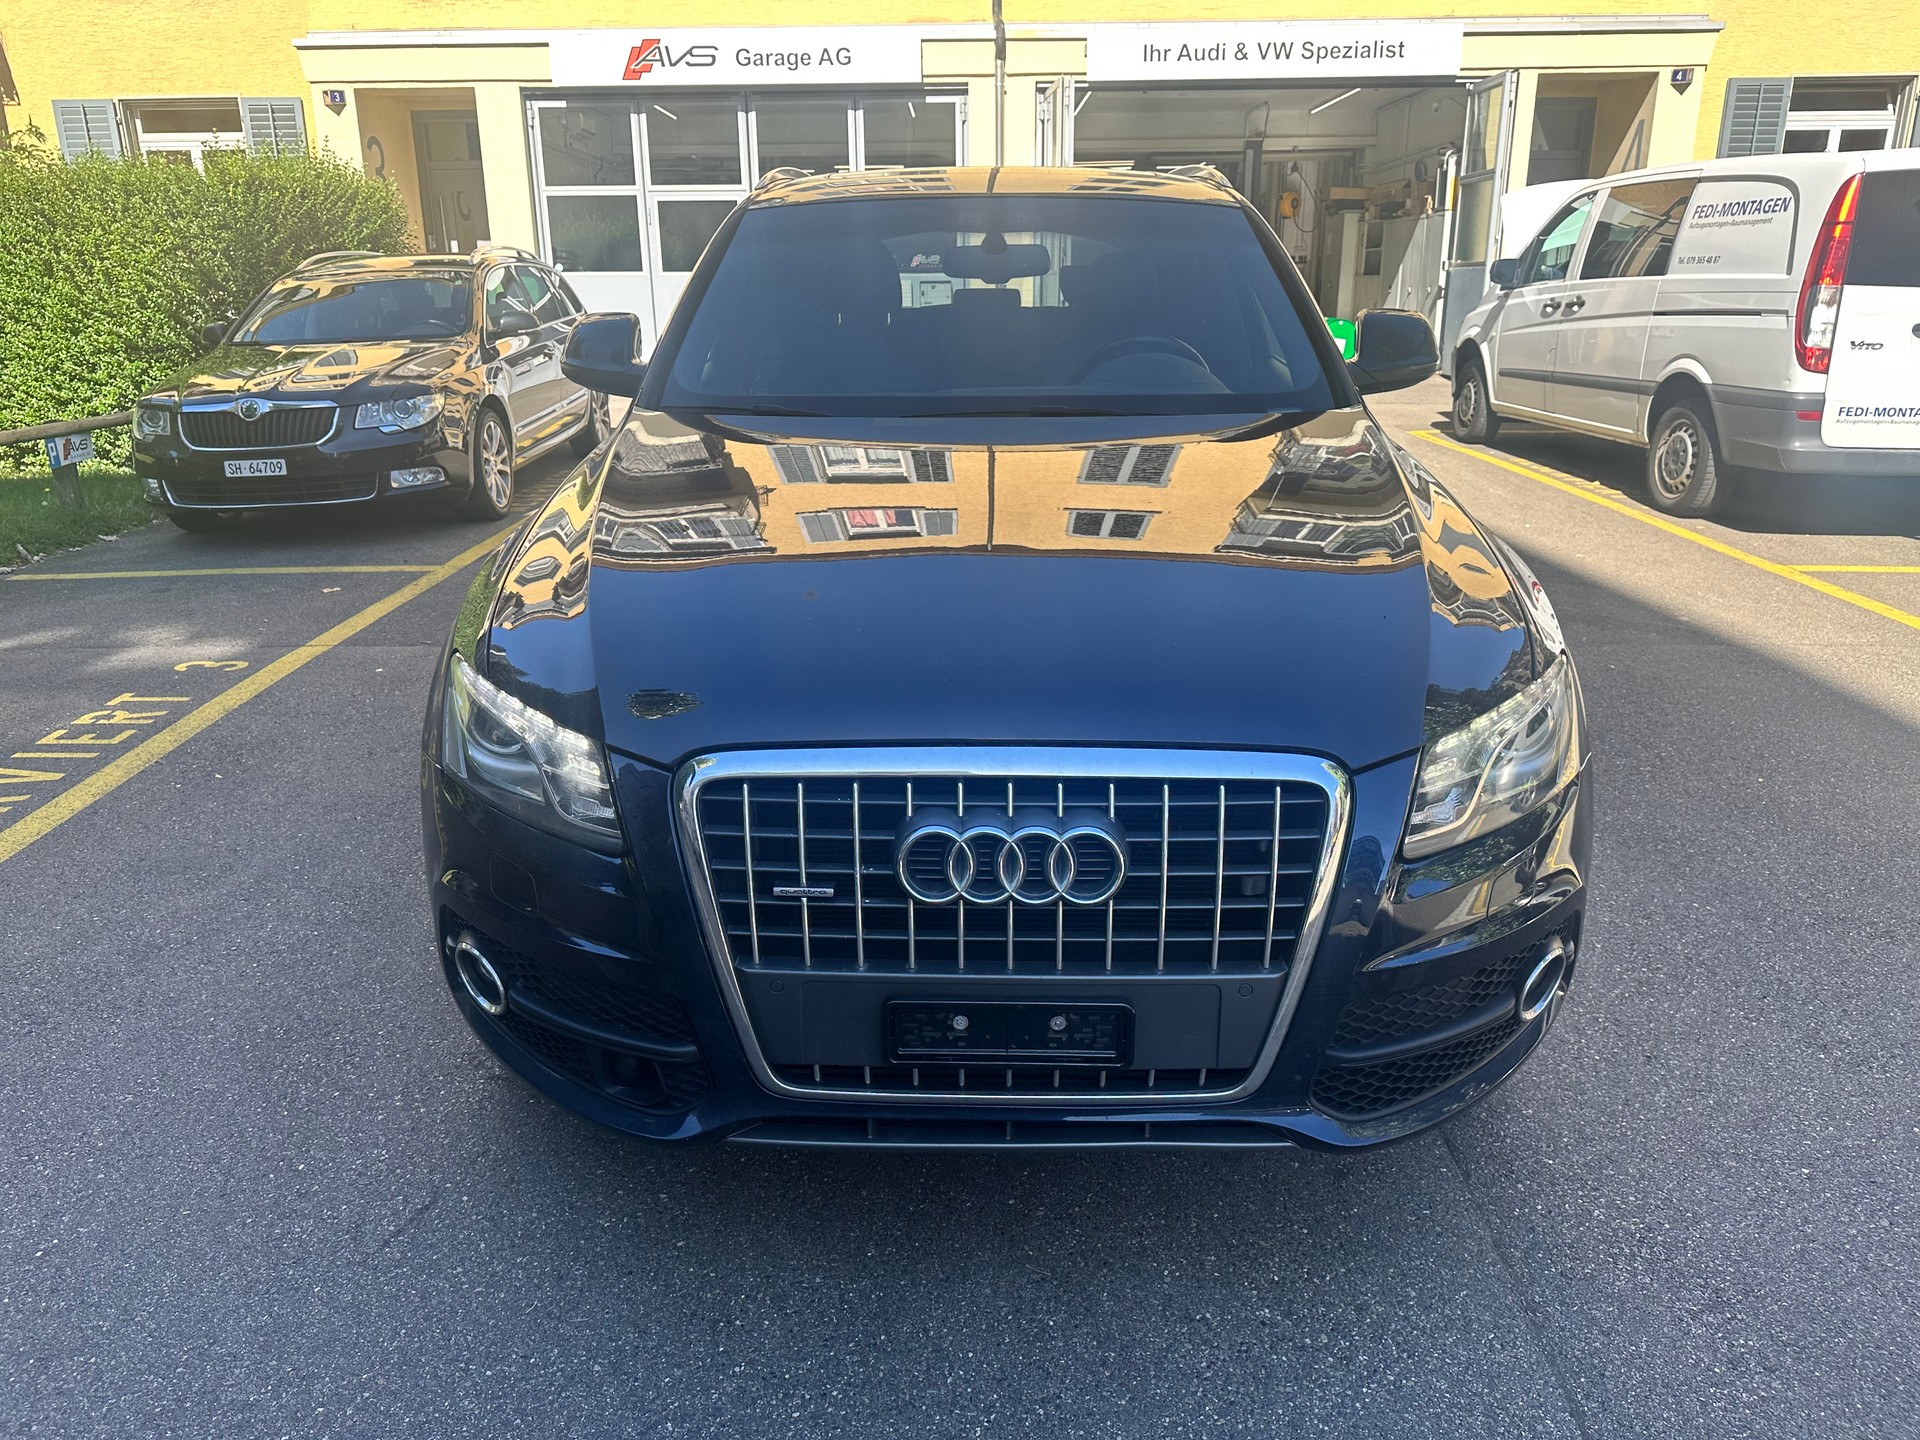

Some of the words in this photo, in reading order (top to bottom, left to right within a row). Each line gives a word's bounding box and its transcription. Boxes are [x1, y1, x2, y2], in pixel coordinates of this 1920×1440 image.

[633, 45, 719, 68] AVS
[735, 48, 811, 71] Garage
[818, 47, 852, 66] AG
[1143, 44, 1171, 62] Ihr
[1177, 43, 1226, 61] Audi
[1234, 42, 1249, 61] &
[1257, 41, 1294, 60] VW
[1301, 40, 1405, 64] Spezialist
[1675, 70, 1683, 81] 4
[334, 92, 340, 102] 3
[1692, 197, 1792, 219] FEDI-MONTAGEN
[227, 462, 243, 475] SH
[248, 461, 283, 475] 64709
[0, 692, 192, 813] VIERT
[174, 660, 249, 672] 3
